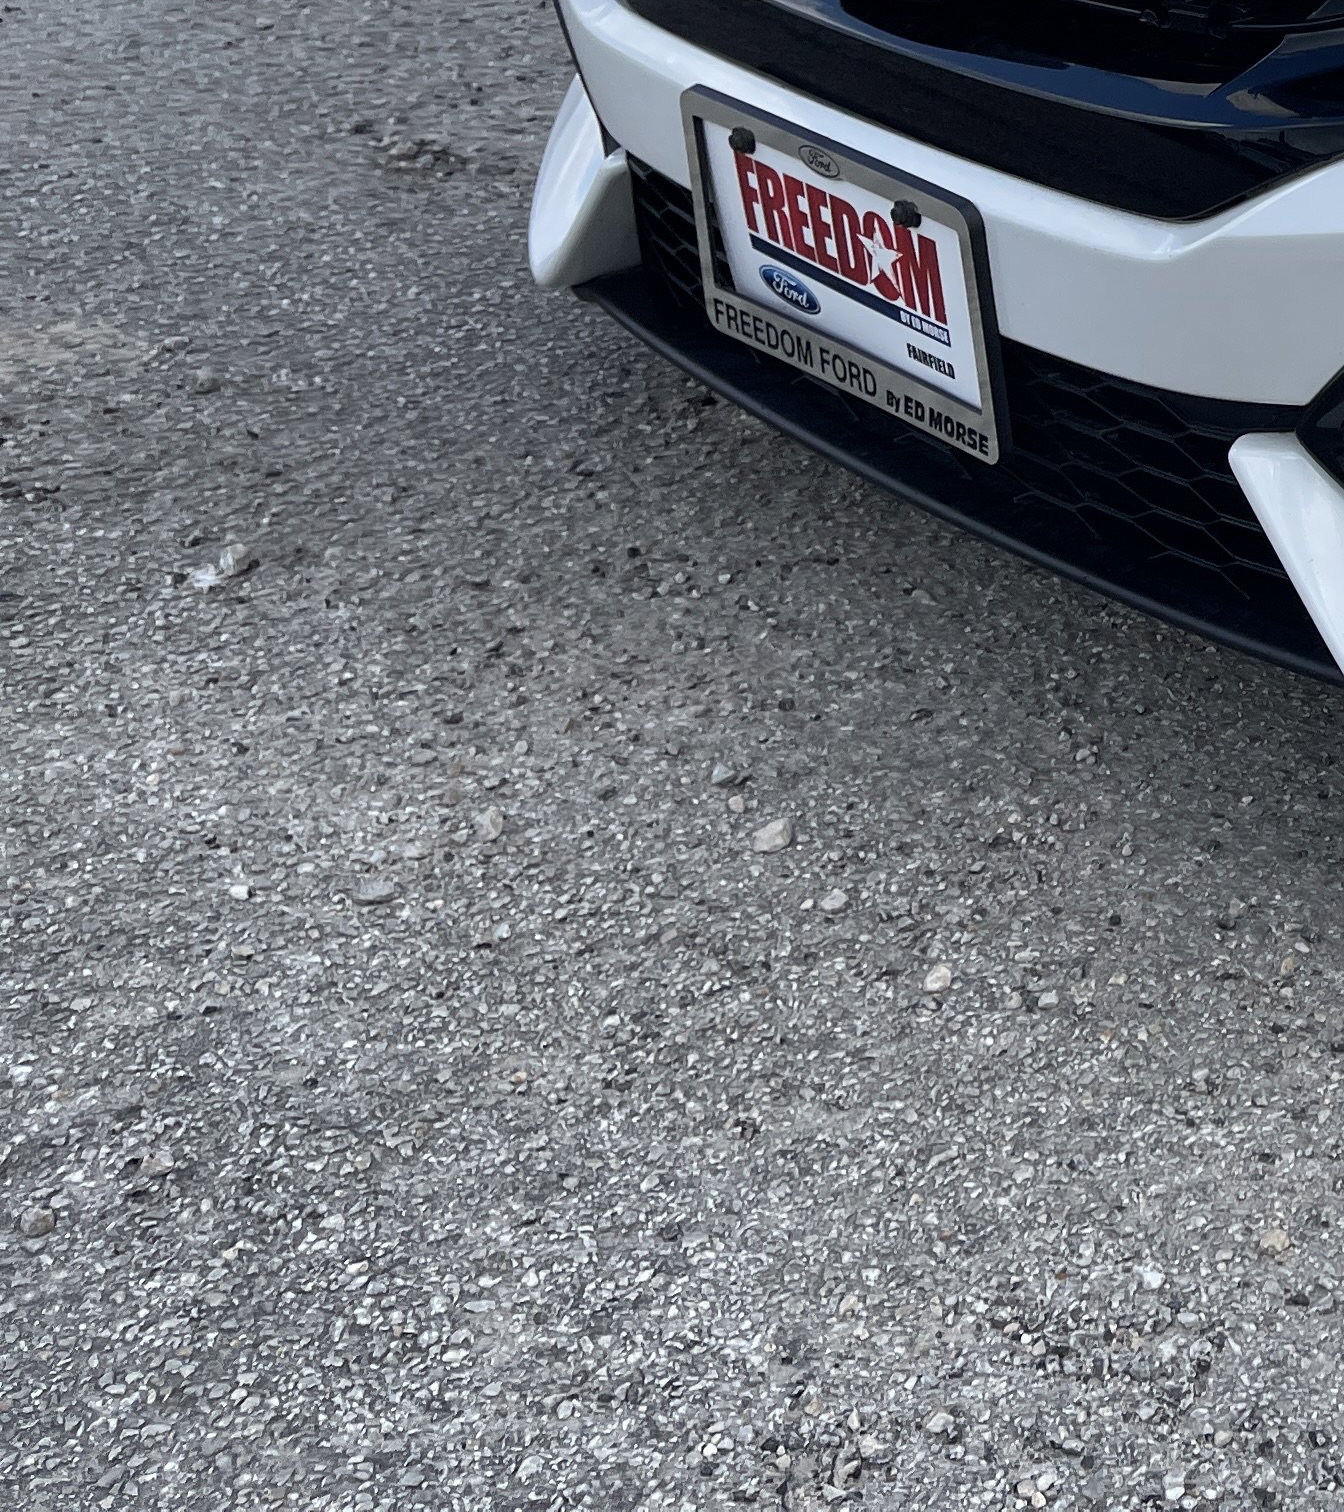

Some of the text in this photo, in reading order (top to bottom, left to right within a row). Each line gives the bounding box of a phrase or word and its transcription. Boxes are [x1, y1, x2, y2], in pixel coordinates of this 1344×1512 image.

[807, 148, 832, 173] Ford
[734, 150, 948, 326] FREEDOM
[771, 271, 810, 309] Ford
[713, 298, 814, 368] FREEDOM
[819, 346, 878, 398] FORD
[903, 393, 925, 423] ED
[928, 406, 989, 457] MORSE
[906, 342, 956, 380] FAIRFIELD
